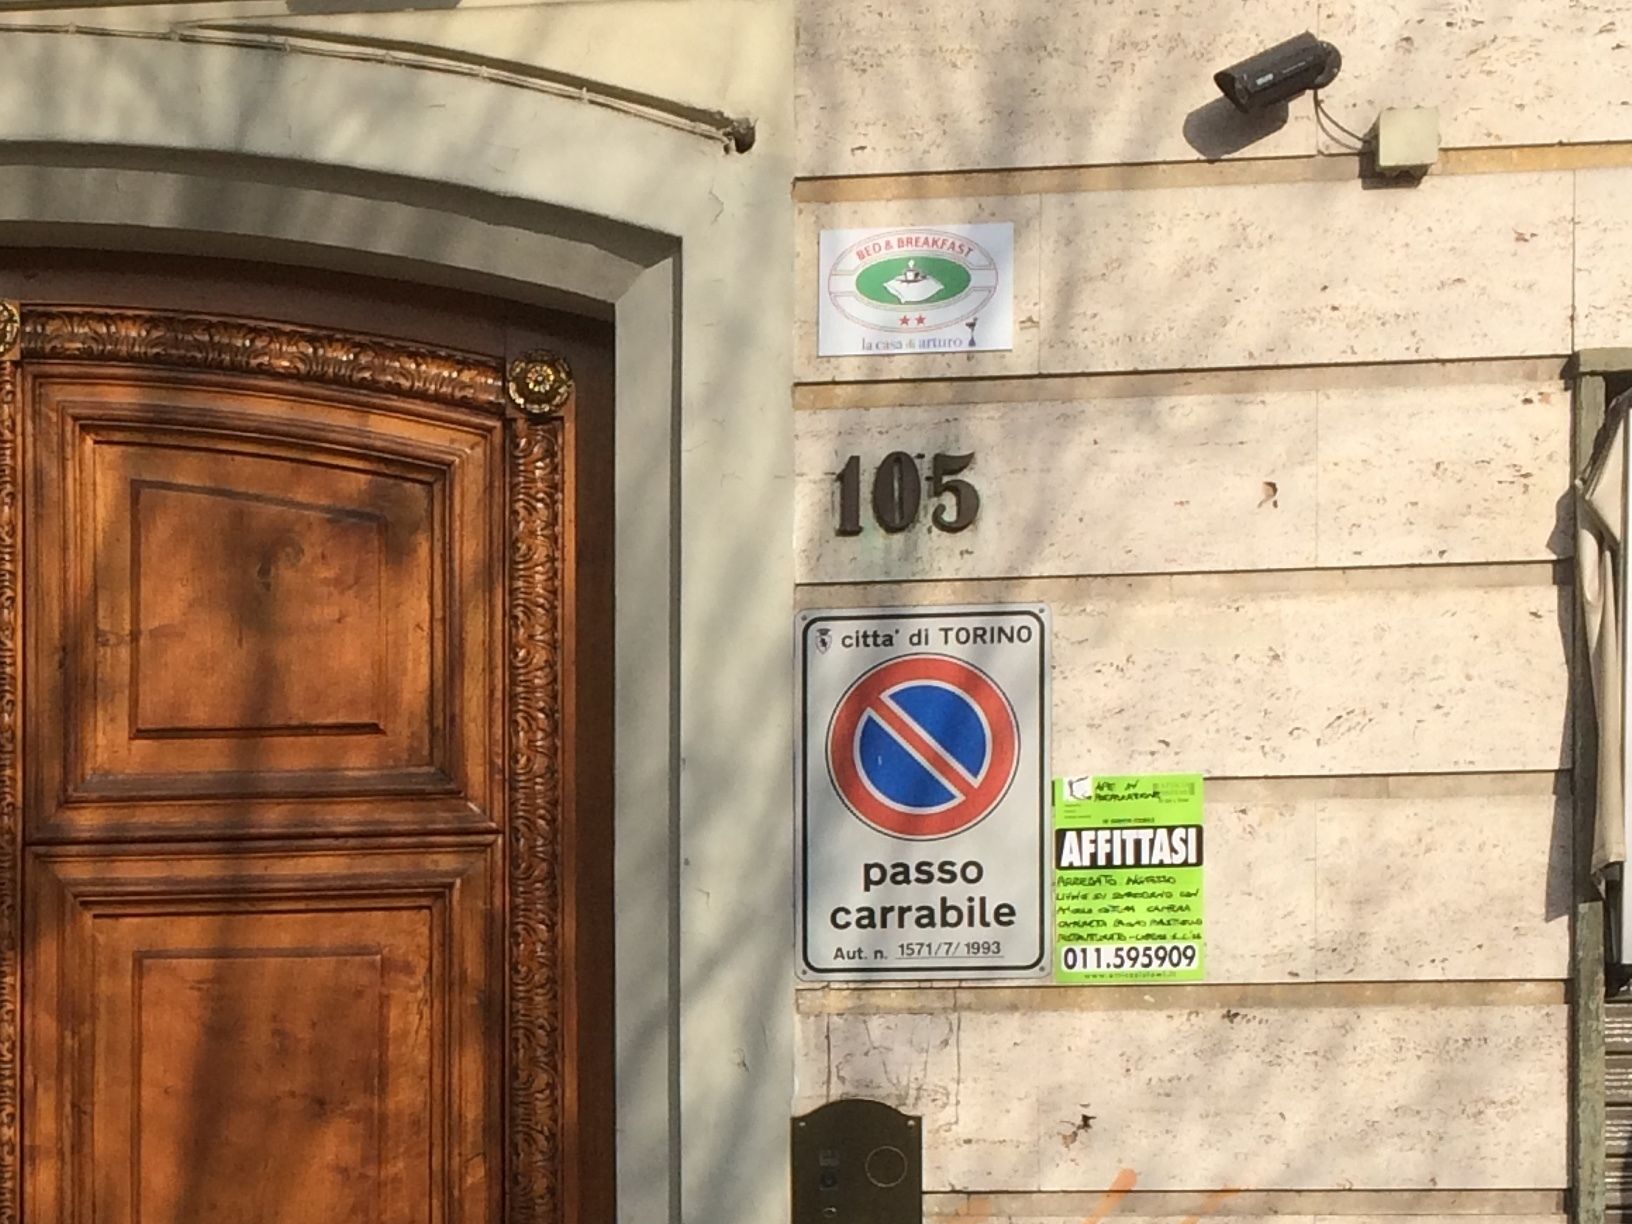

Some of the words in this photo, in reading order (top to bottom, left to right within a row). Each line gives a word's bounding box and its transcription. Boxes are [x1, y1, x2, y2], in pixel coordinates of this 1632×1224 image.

[855, 242, 882, 261] BED
[884, 240, 894, 250] &
[897, 236, 974, 258] BREAKFAST
[862, 338, 872, 351] la
[875, 339, 903, 350] casa
[918, 336, 963, 349] arturo
[835, 451, 981, 537] 105
[909, 628, 929, 646] di
[939, 625, 1033, 645] TORINO
[1060, 827, 1197, 867] AFFITTASI
[863, 860, 984, 892] passo
[830, 896, 1017, 930] carrabile
[833, 947, 868, 960] Aut.
[873, 949, 888, 960] n.
[1063, 945, 1196, 970] 011.595909
